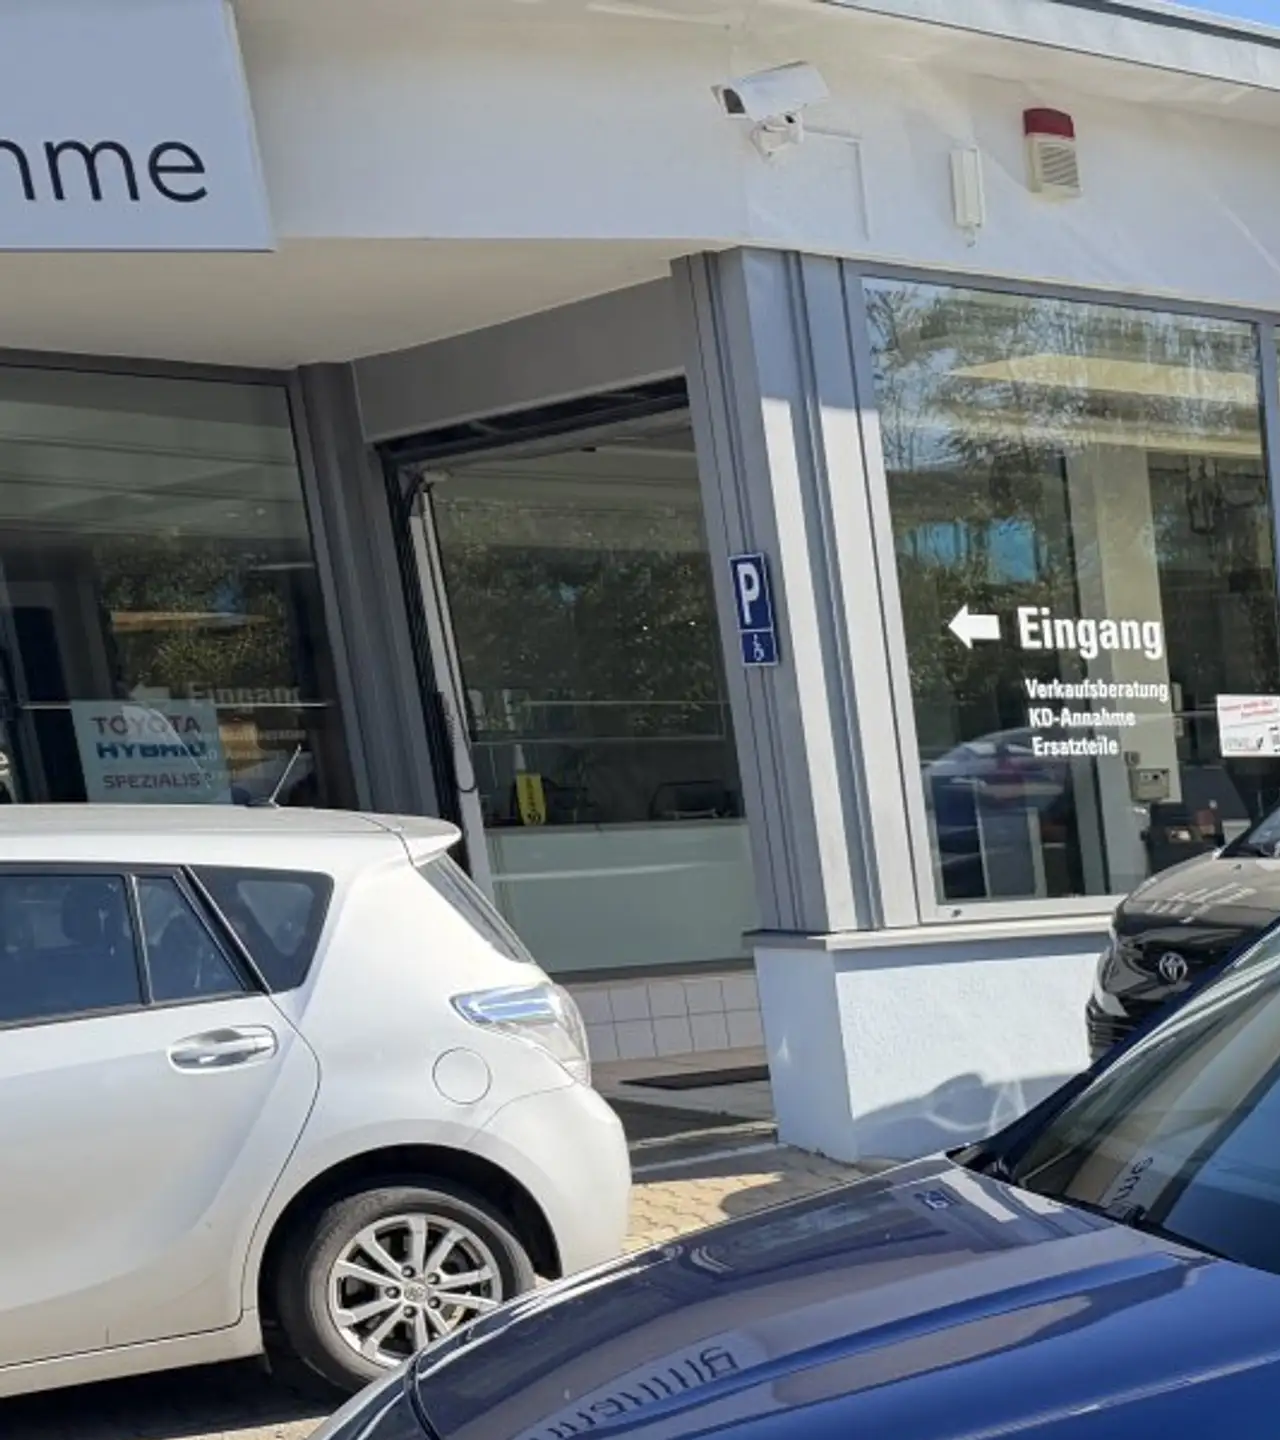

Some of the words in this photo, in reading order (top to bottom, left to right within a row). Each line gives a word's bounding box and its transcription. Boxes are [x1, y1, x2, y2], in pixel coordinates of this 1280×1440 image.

[737, 563, 760, 625] P
[1017, 606, 1163, 660] Eingang
[1025, 678, 1170, 703] Verkaufsberatung
[92, 714, 201, 736] TOYOTA
[1029, 708, 1136, 728] KD-Annahme
[1032, 735, 1119, 757] Ersatzteile
